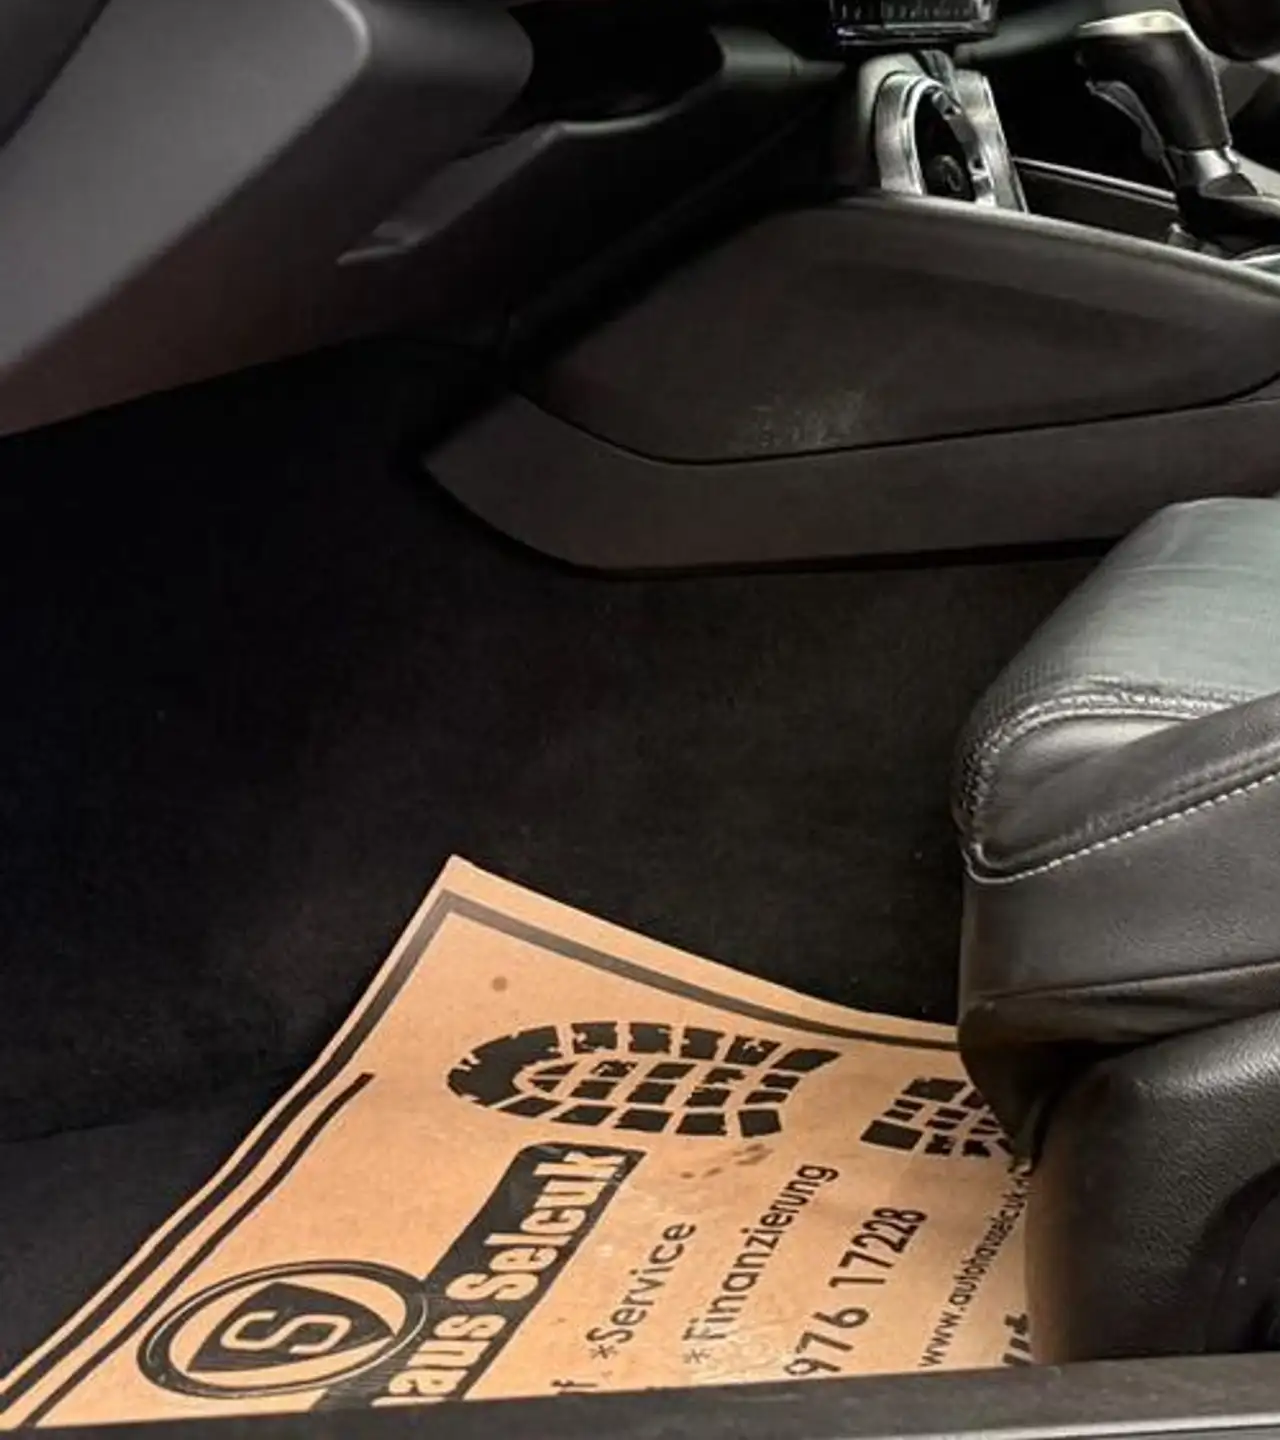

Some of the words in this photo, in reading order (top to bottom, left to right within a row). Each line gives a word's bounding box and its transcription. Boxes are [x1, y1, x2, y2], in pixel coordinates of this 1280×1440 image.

[445, 1150, 629, 1302] Selcuk
[681, 1163, 840, 1343] Finanzierung
[783, 1305, 870, 1377] 976
[827, 1206, 928, 1289] 17228
